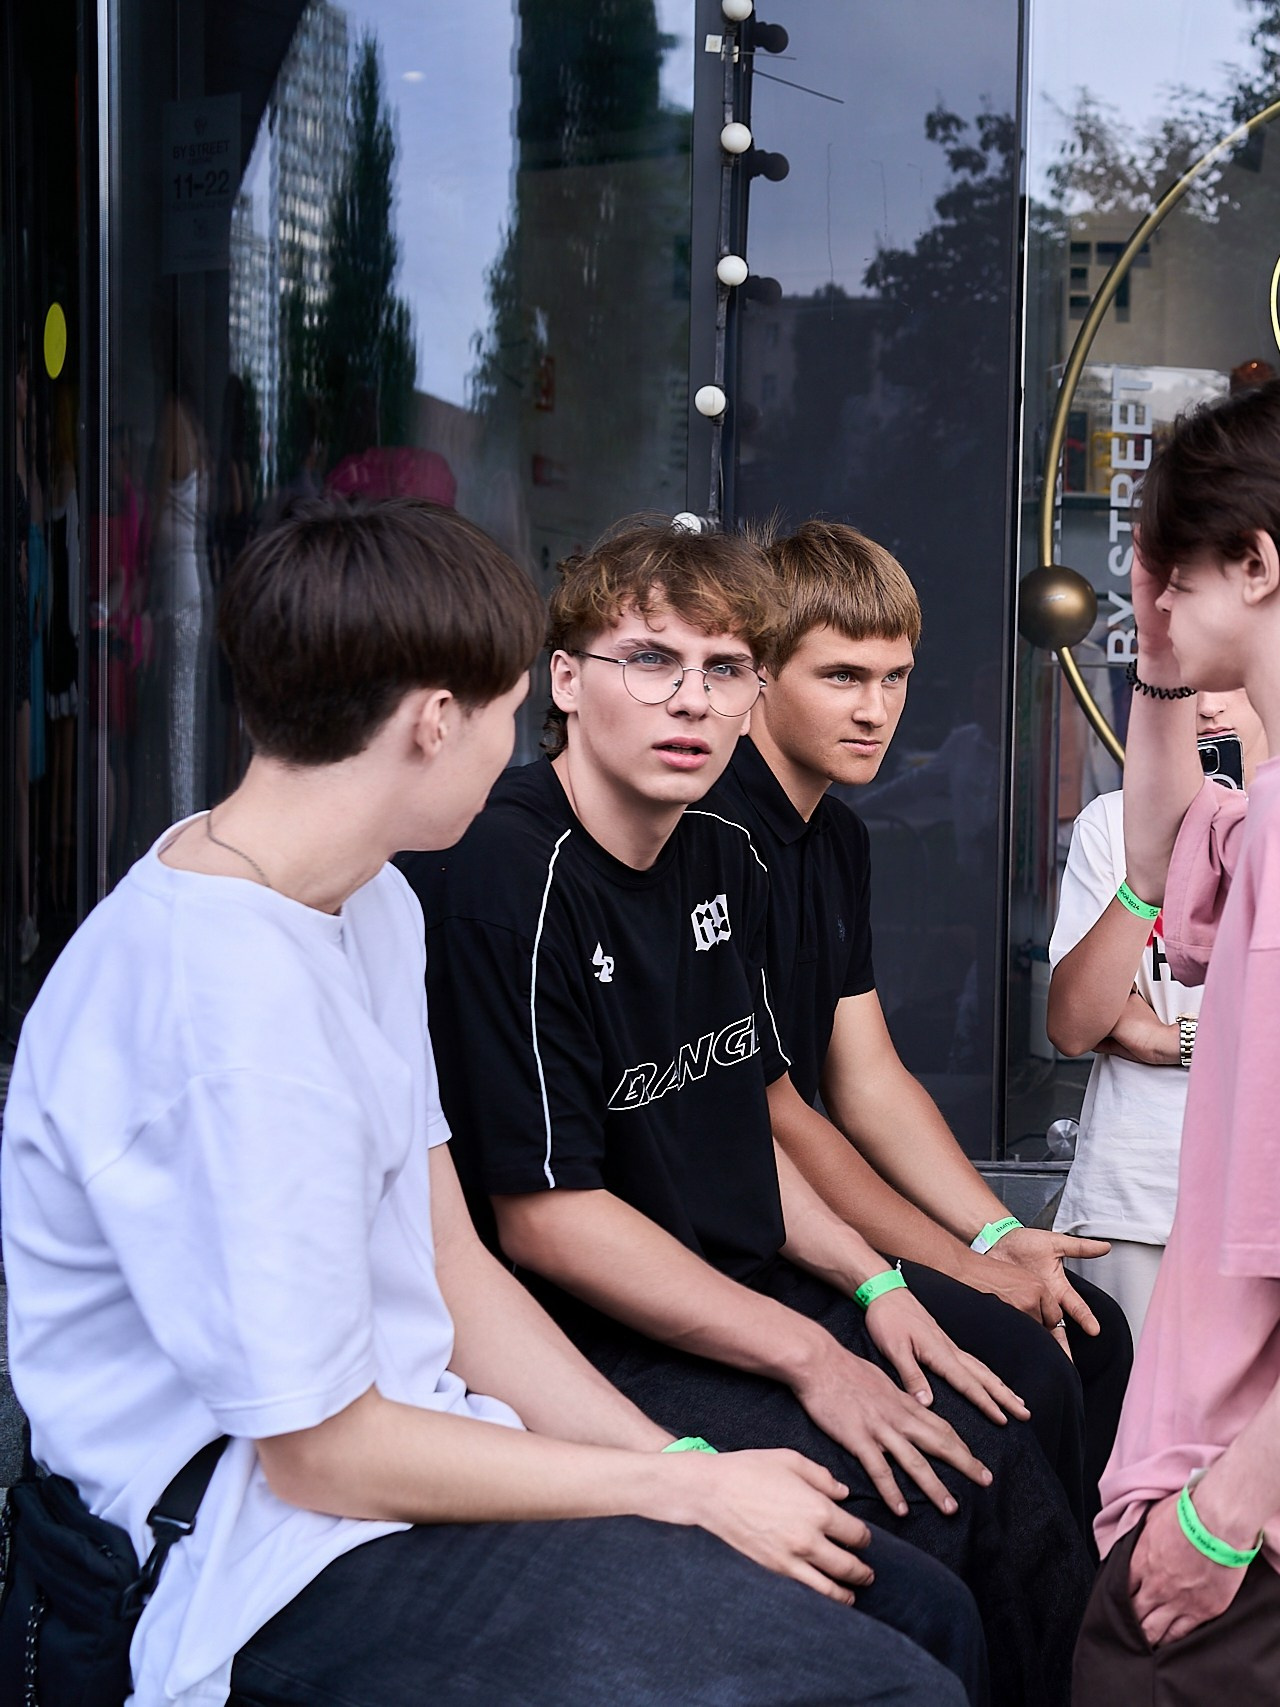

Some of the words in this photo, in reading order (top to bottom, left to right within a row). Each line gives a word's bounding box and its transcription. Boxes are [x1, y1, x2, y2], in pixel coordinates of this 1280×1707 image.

[189, 139, 230, 157] STREET
[173, 168, 230, 200] 11-22
[1107, 367, 1153, 577] STREET
